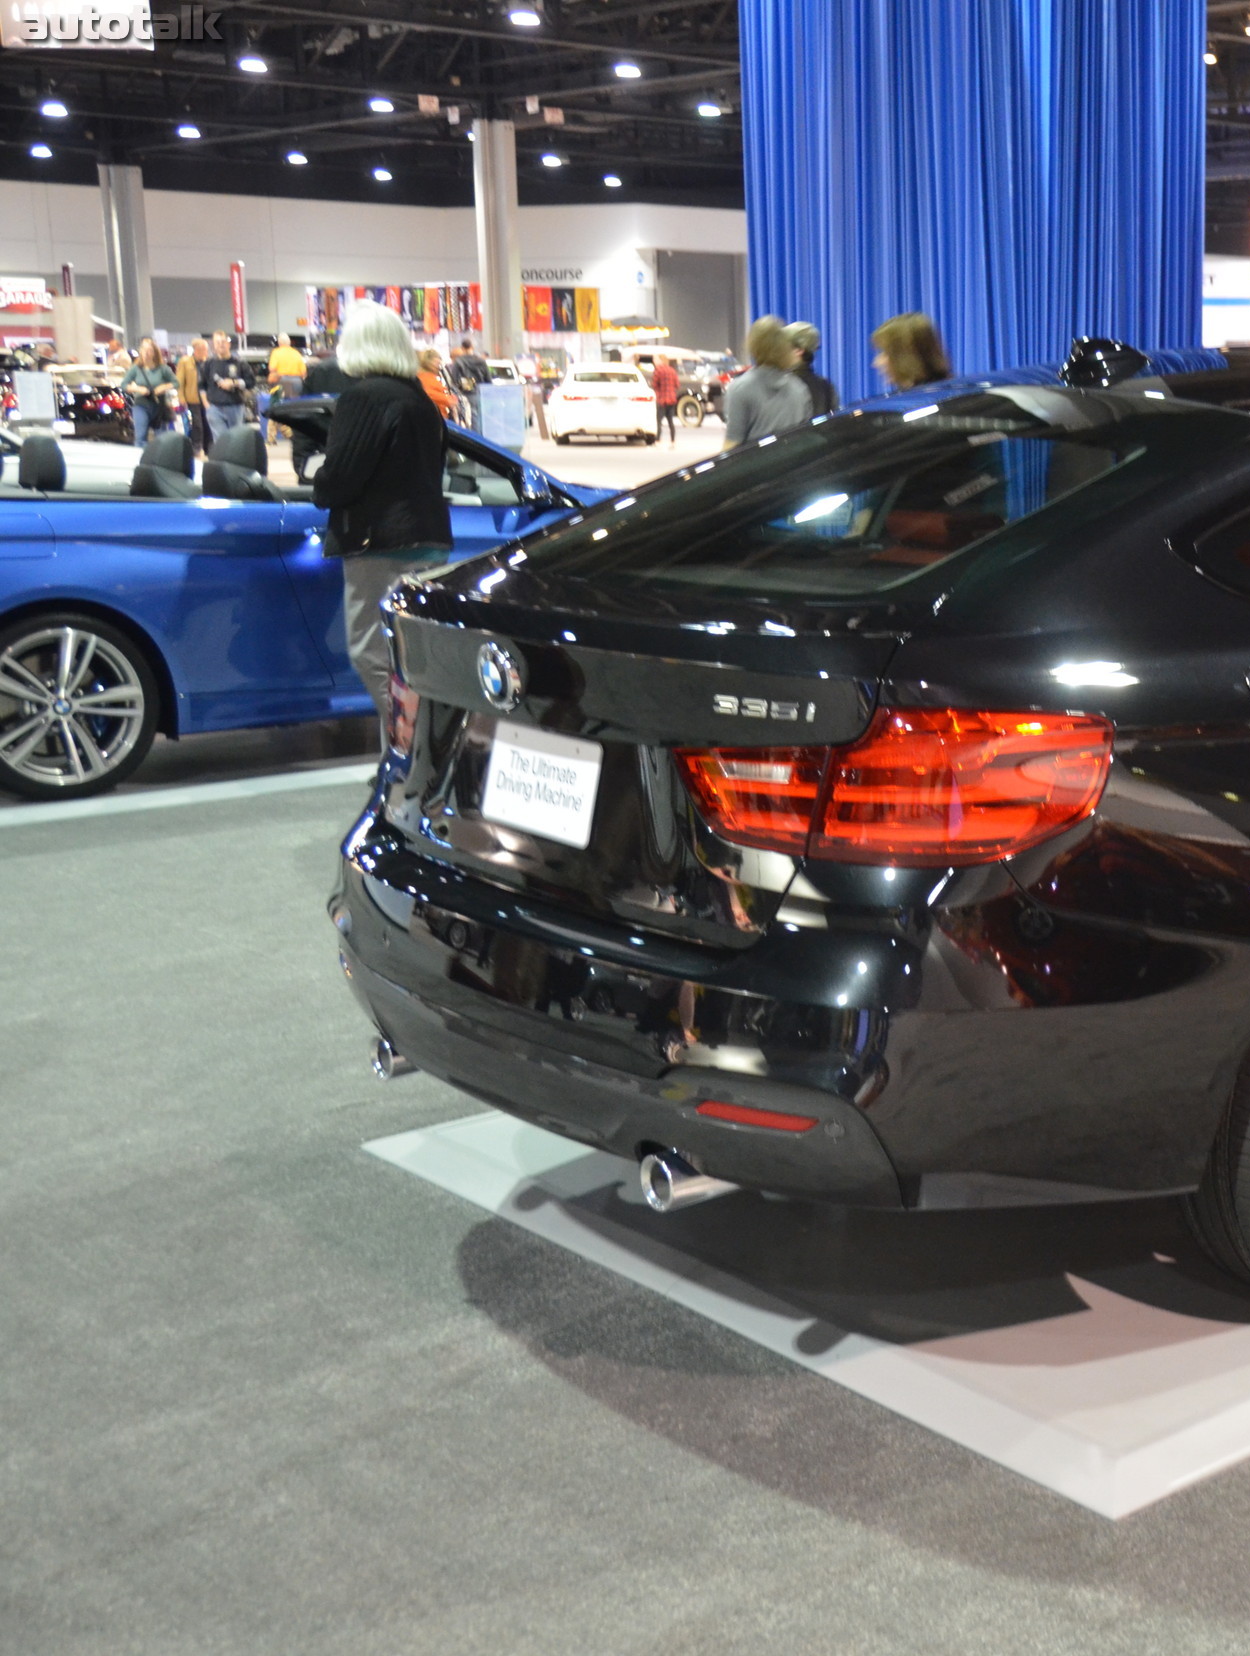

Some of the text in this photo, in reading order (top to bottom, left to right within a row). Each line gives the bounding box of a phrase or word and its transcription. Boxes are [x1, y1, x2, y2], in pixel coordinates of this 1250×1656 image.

[521, 268, 583, 282] oncourse
[712, 693, 816, 723] 335i
[510, 748, 577, 786] The Ultimate
[496, 769, 582, 812] Driving Machine
